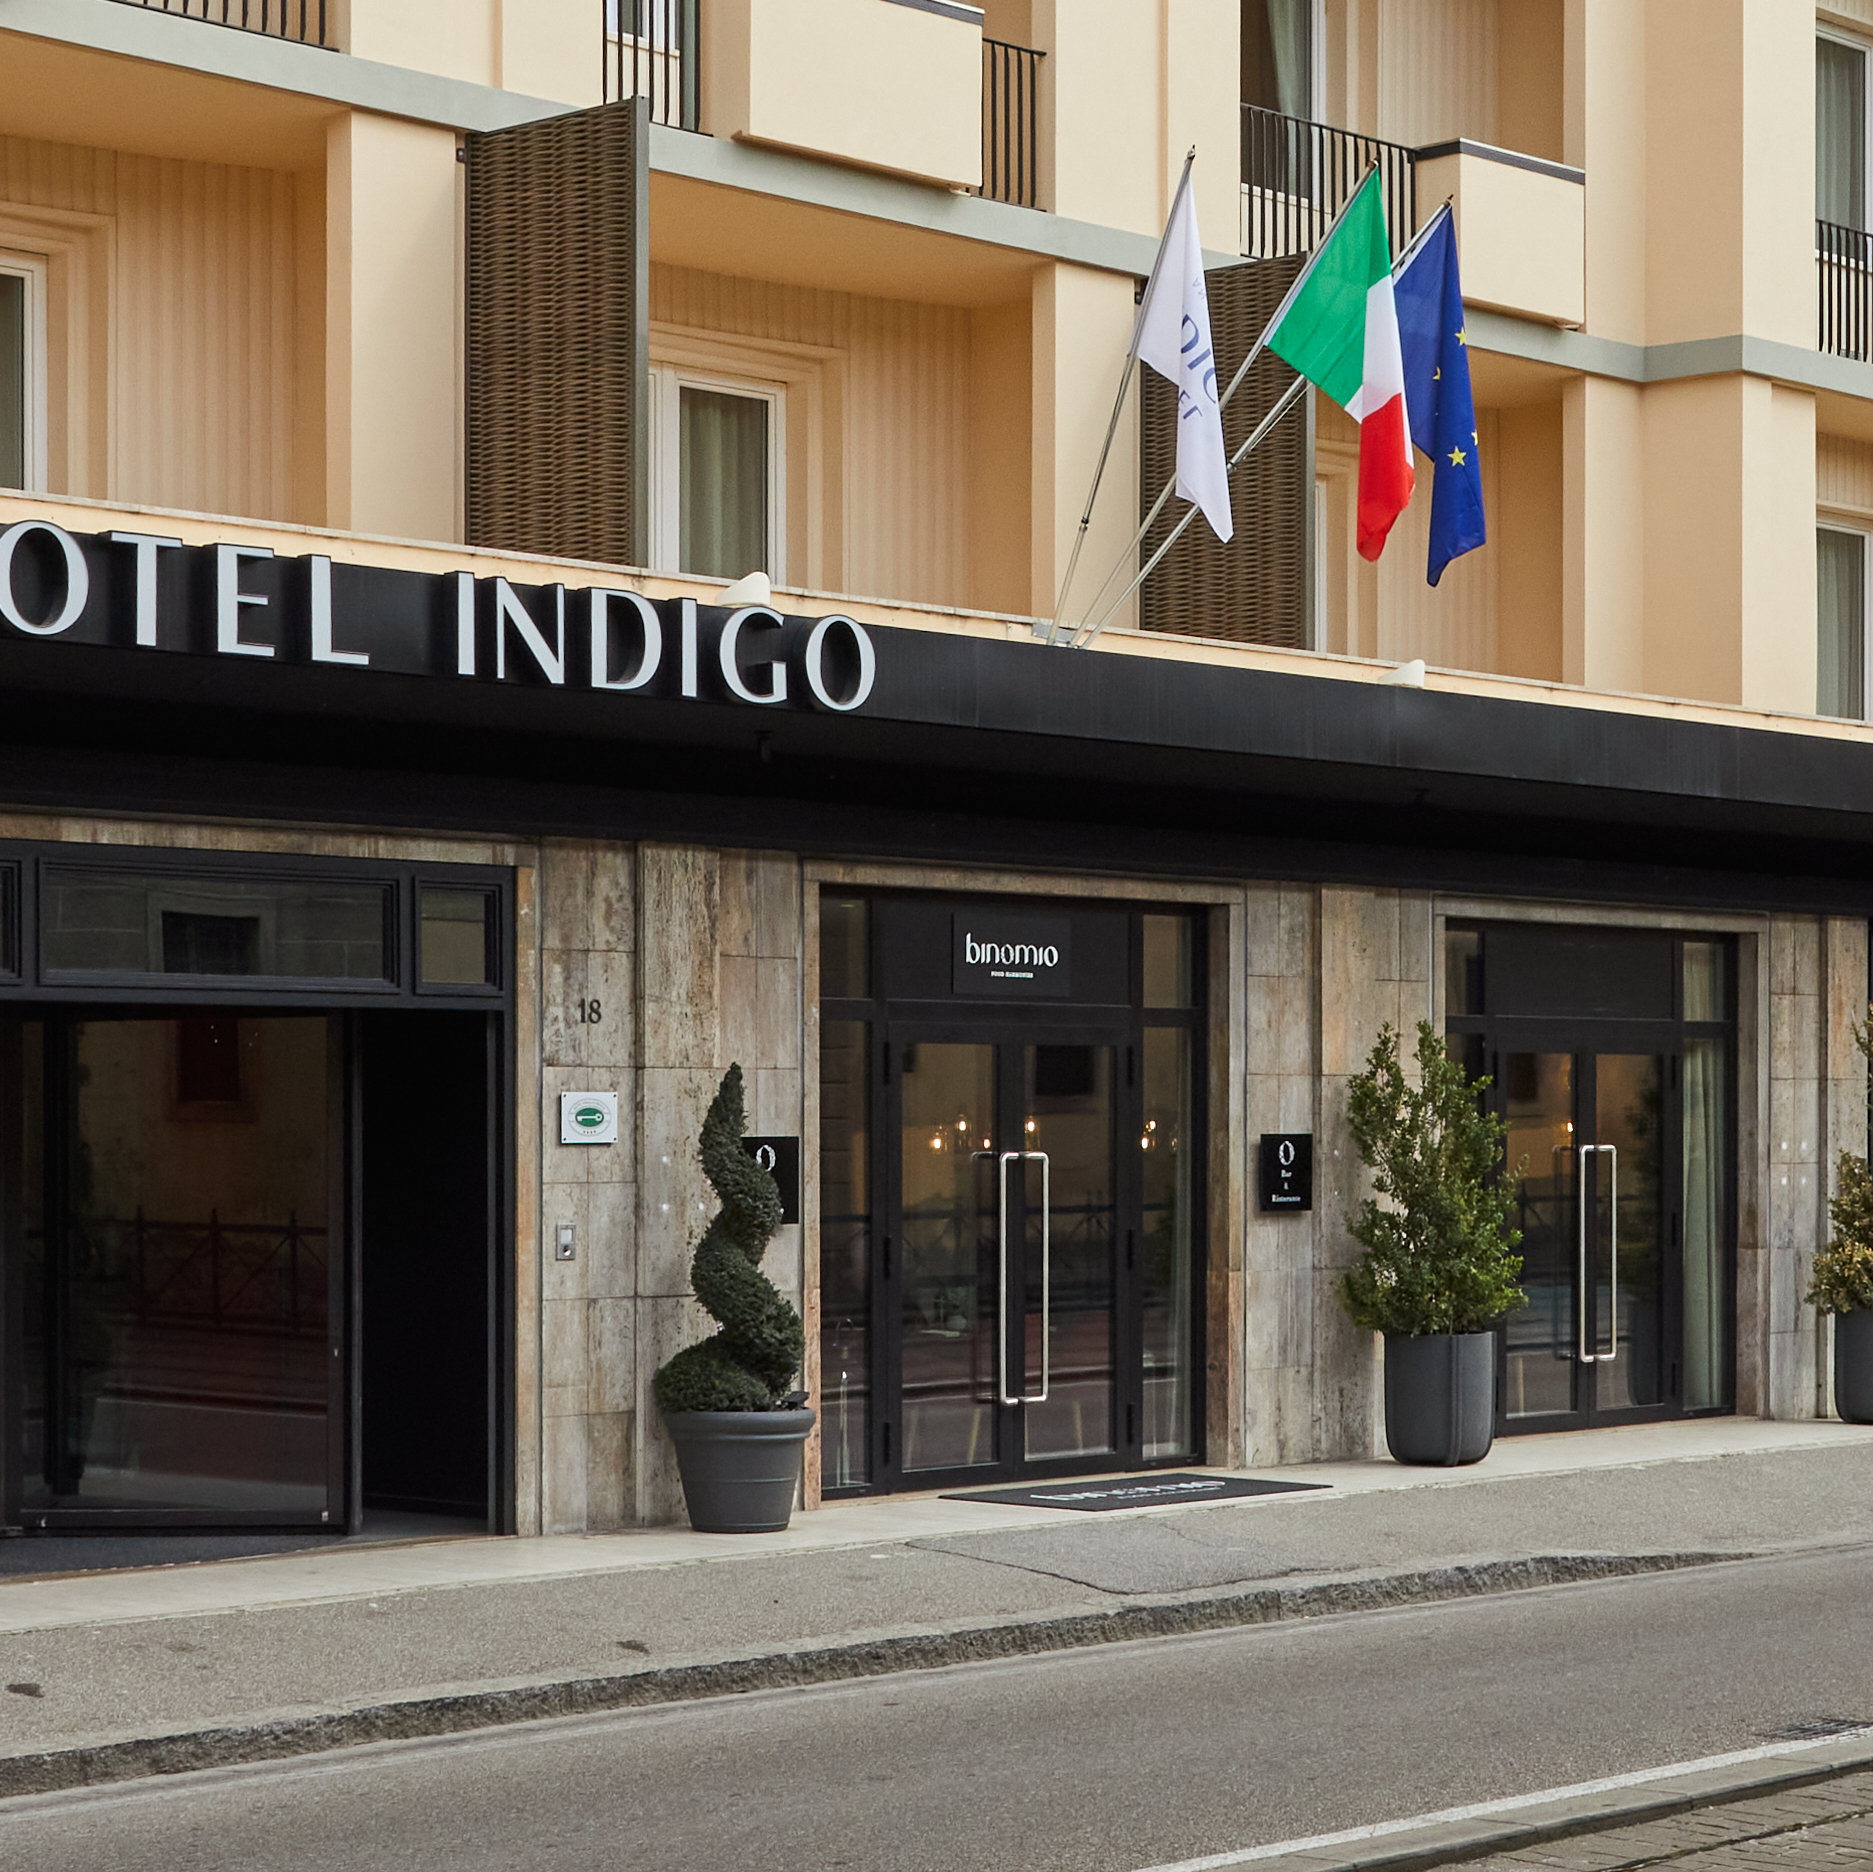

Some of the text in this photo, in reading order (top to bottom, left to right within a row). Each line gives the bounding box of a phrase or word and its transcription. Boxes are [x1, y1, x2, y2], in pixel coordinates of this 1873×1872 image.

[443, 569, 878, 714] INDIGO
[965, 932, 1059, 967] binomio
[578, 999, 603, 1024] 18
